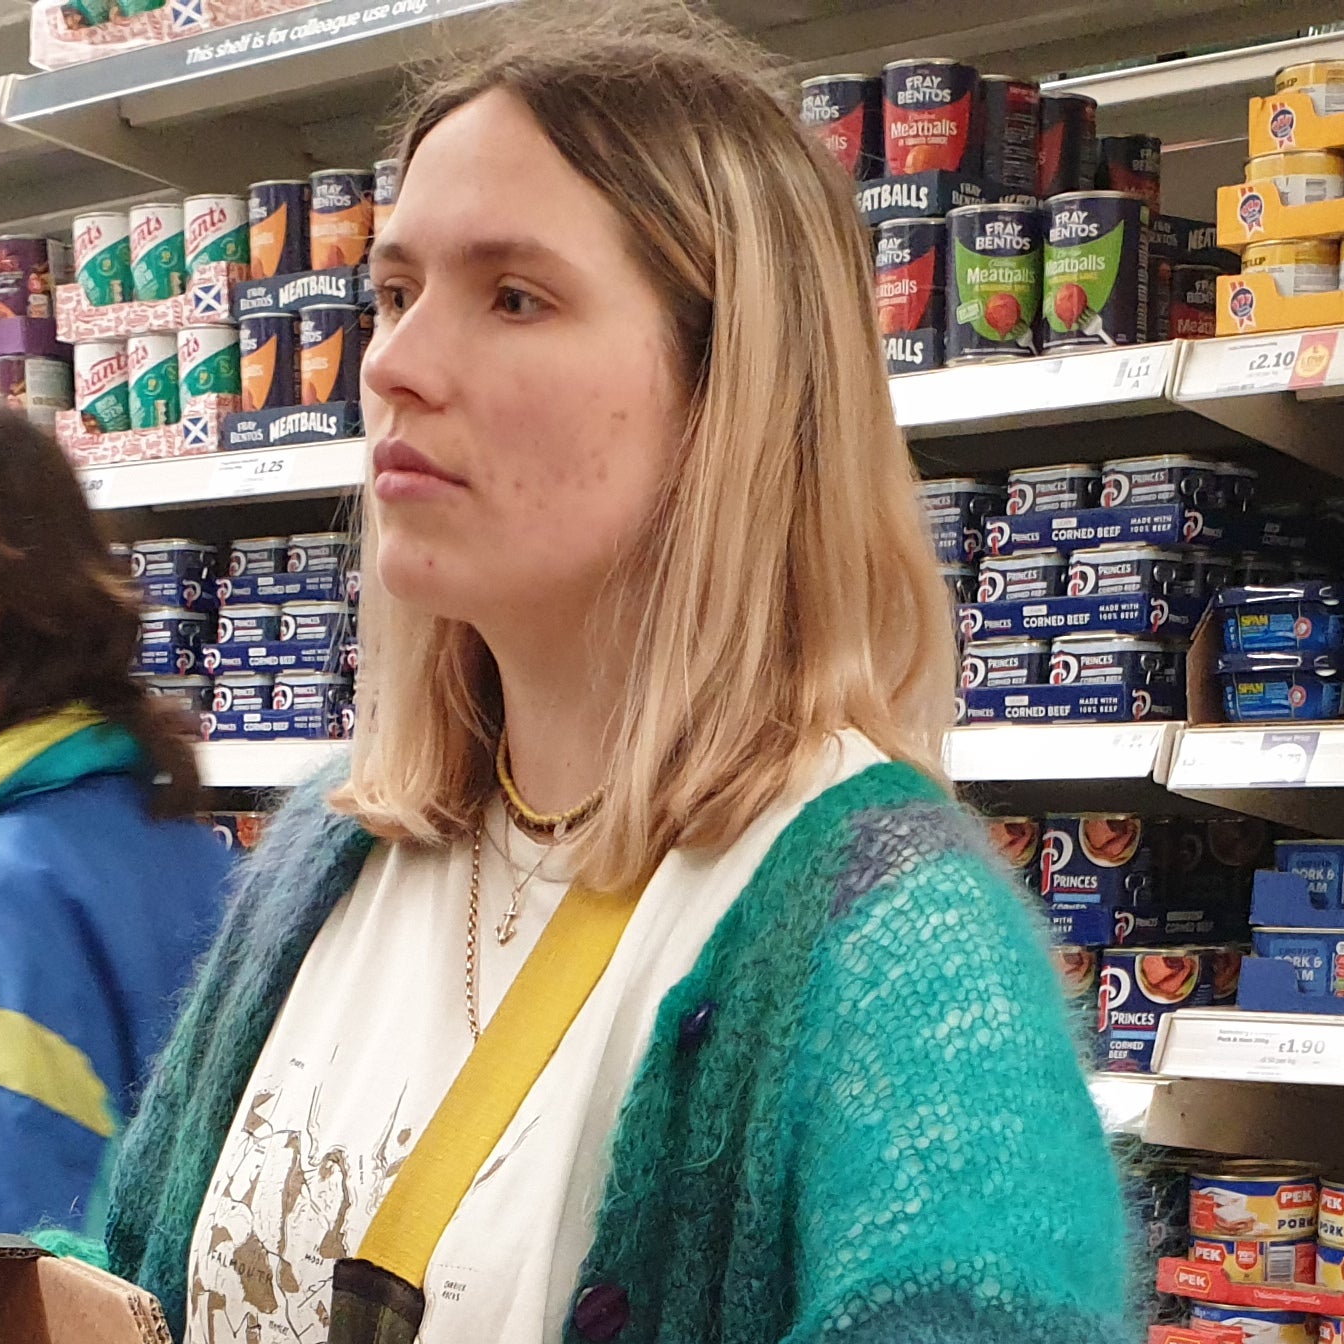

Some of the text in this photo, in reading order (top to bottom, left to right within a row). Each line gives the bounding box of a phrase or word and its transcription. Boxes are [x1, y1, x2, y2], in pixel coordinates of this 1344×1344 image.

[185, 47, 214, 65] This
[215, 34, 252, 58] shelf
[252, 34, 264, 49] is
[266, 25, 287, 47] for
[289, 11, 361, 41] colleague
[362, 4, 390, 24] use
[891, 119, 958, 139] Meatballs
[967, 268, 1035, 284] Meatballs
[279, 276, 346, 308] MEATBALLS
[1249, 351, 1295, 371] £2.10
[269, 413, 338, 442] MEATBALLS
[1052, 526, 1122, 540] CORNED BEEF
[1023, 613, 1090, 627] CORNED BEEF
[1005, 705, 1071, 718] CORNED BEEF
[1109, 1041, 1144, 1052] CORNED
[1278, 1039, 1325, 1054] £1.90
[1277, 1218, 1315, 1230] PORK
